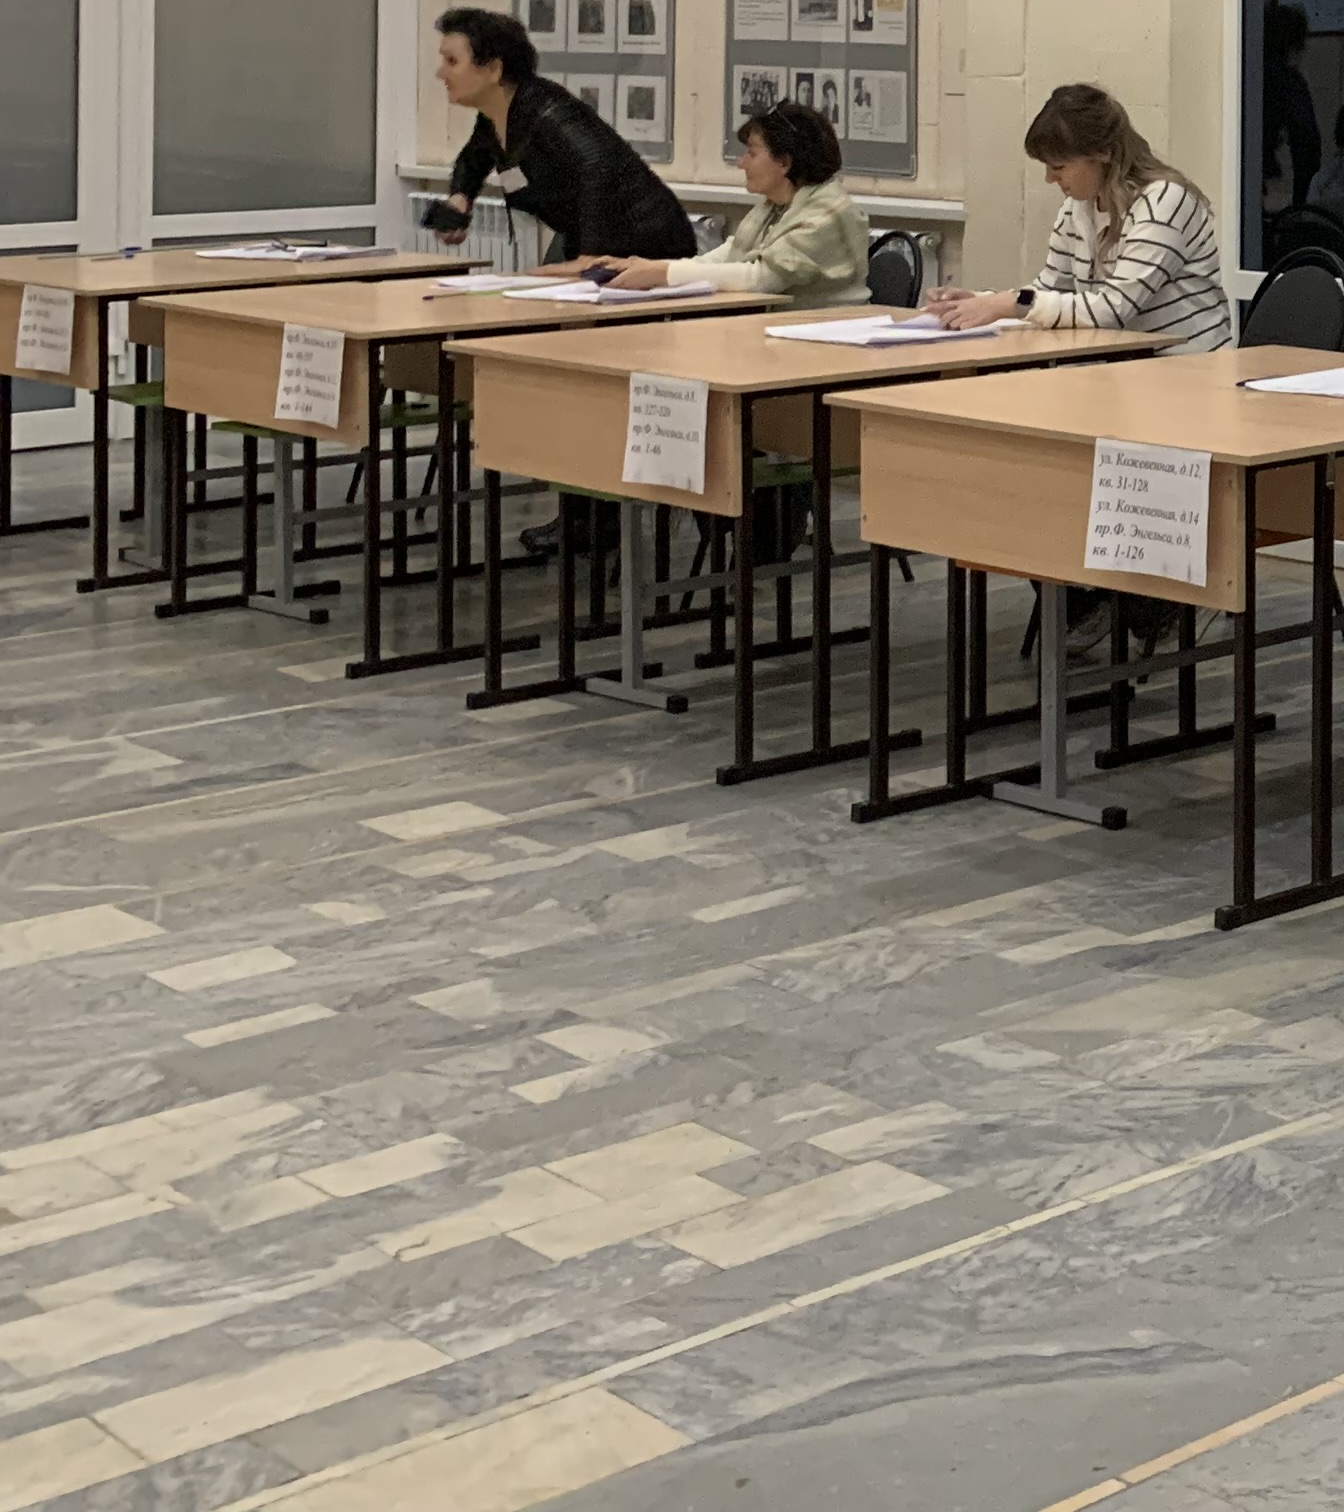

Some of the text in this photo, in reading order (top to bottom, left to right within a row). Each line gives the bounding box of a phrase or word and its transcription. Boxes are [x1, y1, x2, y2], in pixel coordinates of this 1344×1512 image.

[1099, 453, 1113, 467] ул.
[1117, 476, 1149, 493] 31-128
[1096, 500, 1112, 514] ул.
[1180, 510, 1200, 526] д.14
[1092, 544, 1145, 561] кв. 1-126
